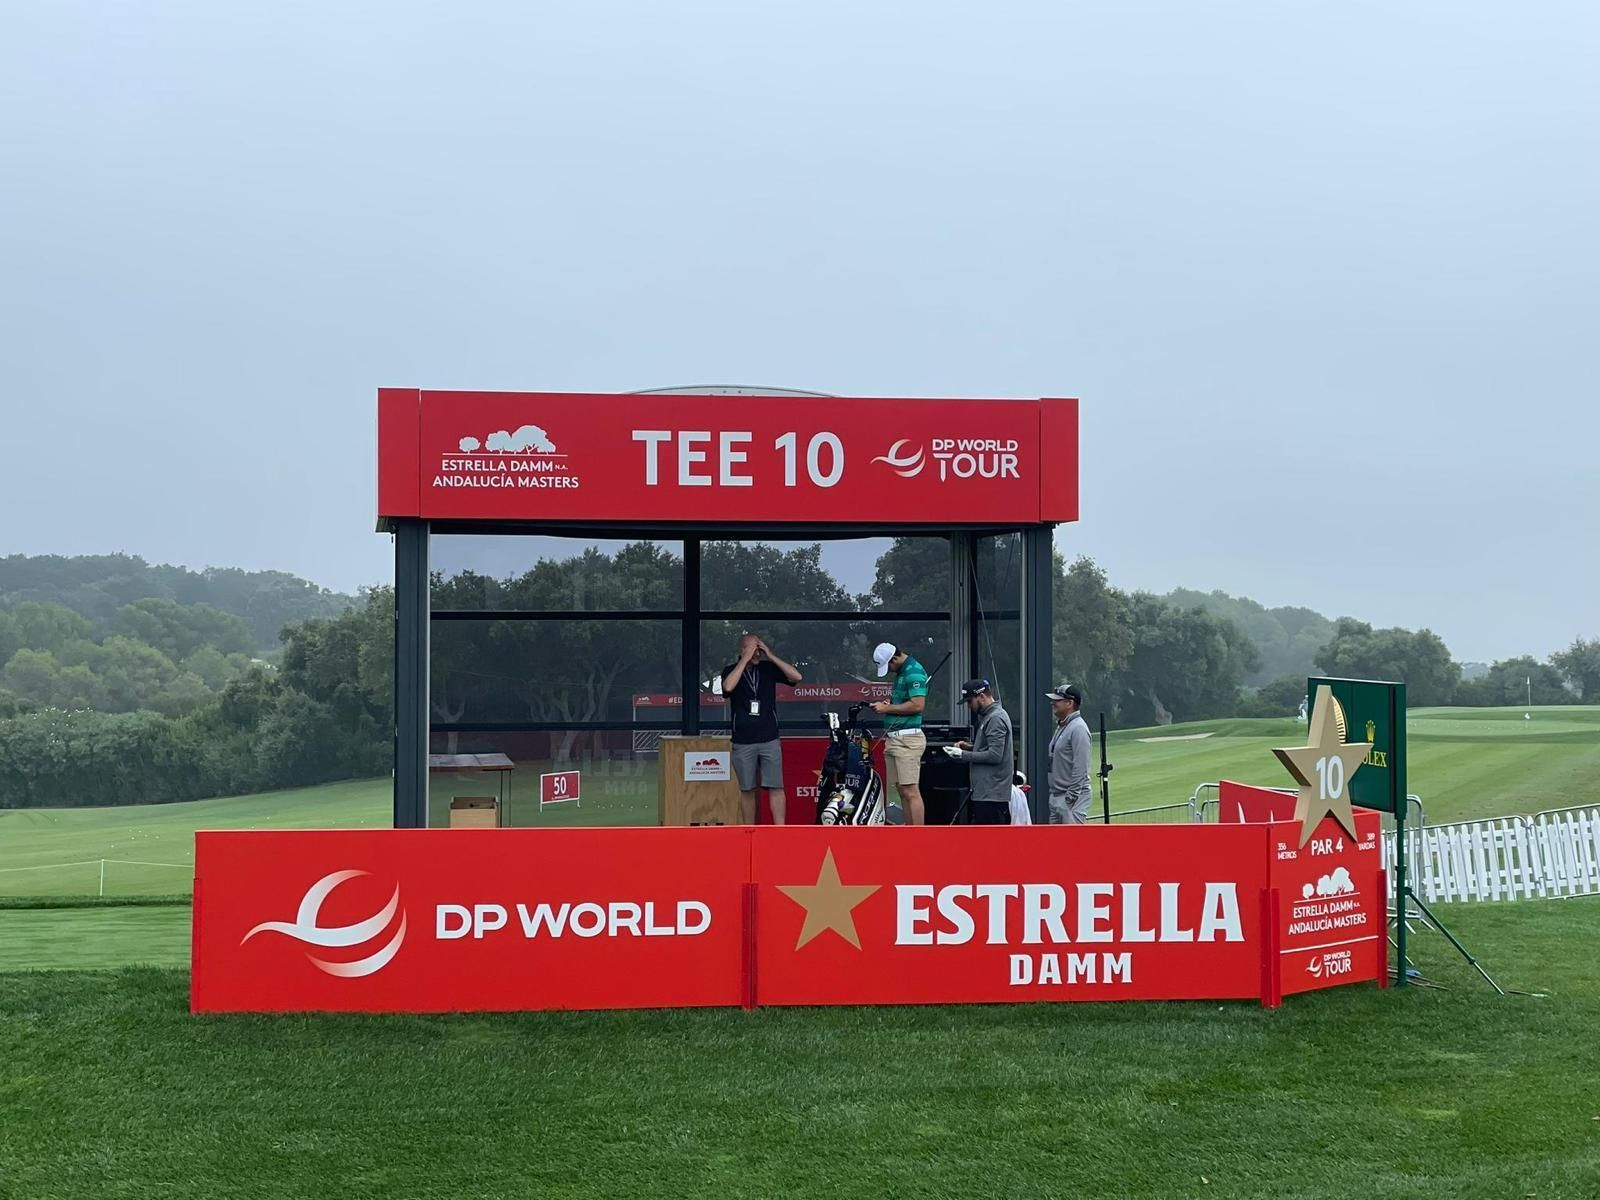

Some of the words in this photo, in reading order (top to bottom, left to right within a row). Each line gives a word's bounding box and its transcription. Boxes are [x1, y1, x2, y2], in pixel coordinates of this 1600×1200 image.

[932, 439, 955, 451] DP
[957, 439, 1019, 452] WORLD
[441, 459, 507, 472] ESTRELLA
[510, 460, 553, 472] DAMM
[631, 429, 753, 487] TEE
[775, 431, 845, 488] 10
[932, 452, 1020, 482] TOUR
[432, 472, 515, 488] ANDALUCÍA
[518, 476, 579, 489] MASTERS
[794, 687, 842, 697] GIMNASIO
[1363, 750, 1387, 767] OLEX
[553, 776, 567, 795] 50
[1315, 755, 1344, 800] 10
[1310, 837, 1334, 856] PAR
[1335, 836, 1344, 853] 4
[894, 882, 1245, 946] ESTRELLA
[1293, 904, 1329, 919] ESTRELLA
[1329, 900, 1353, 914] DAMM
[436, 904, 508, 939] DP
[517, 901, 712, 939] WORLD
[1288, 916, 1333, 936] ANDALUCÍA
[1333, 912, 1367, 929] MASTERS
[1323, 953, 1332, 961] DP
[1331, 950, 1352, 960] WORLD
[1009, 952, 1133, 986] DAMM
[1323, 958, 1352, 978] TOUR
